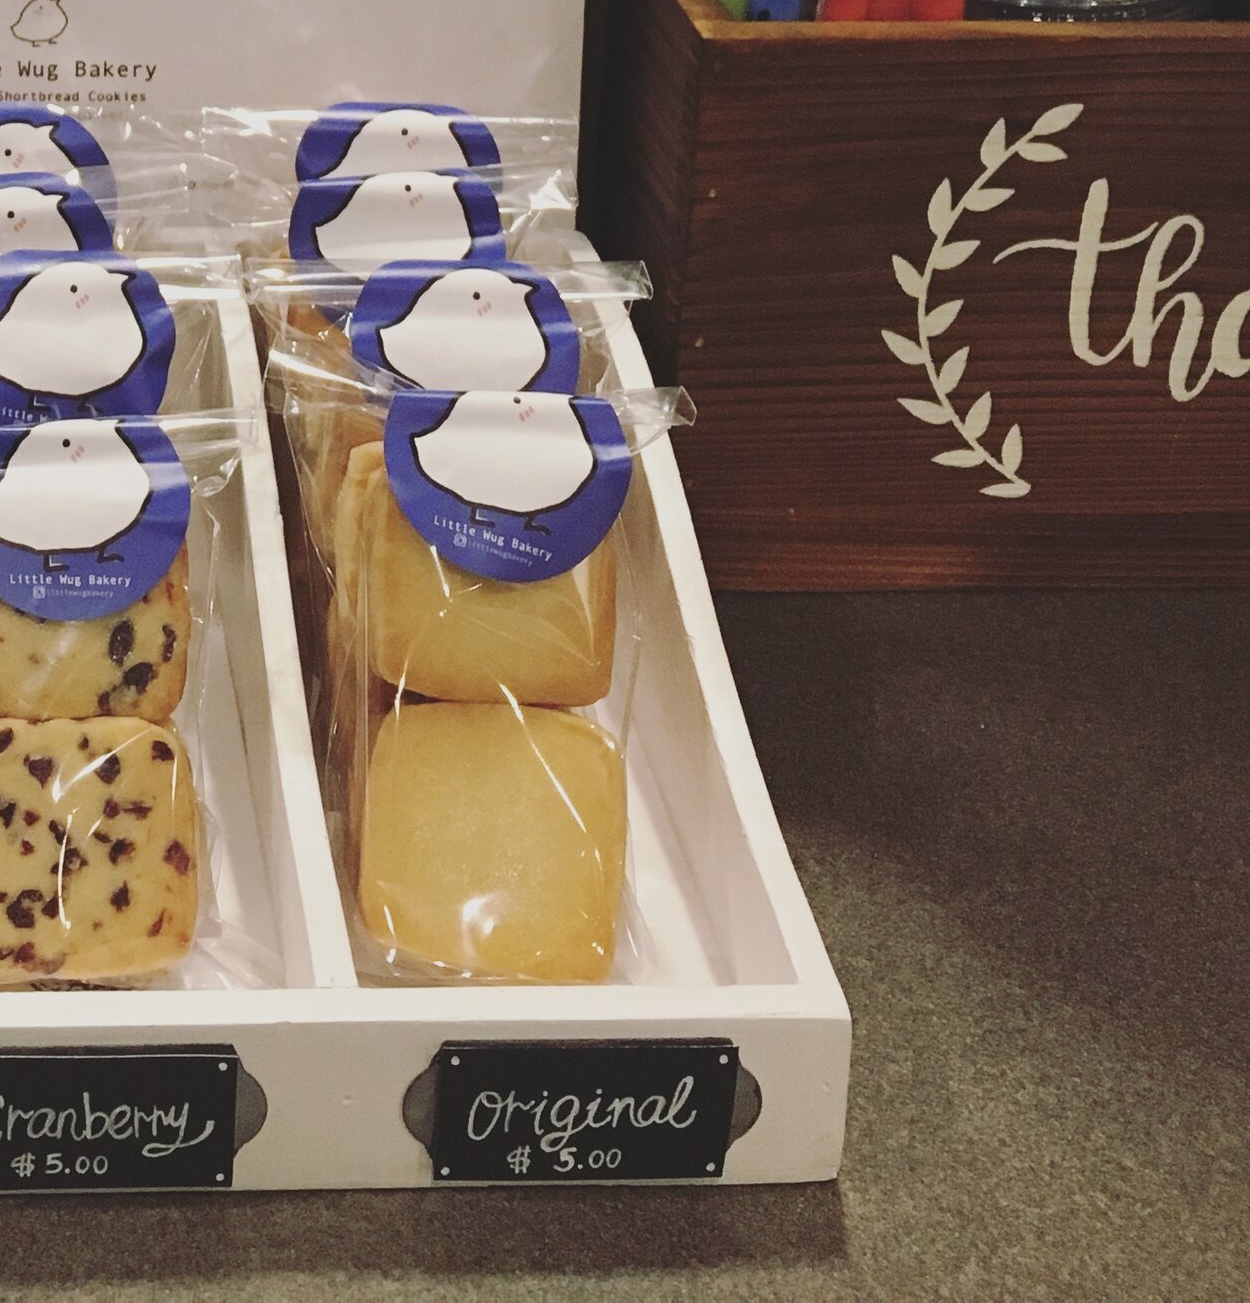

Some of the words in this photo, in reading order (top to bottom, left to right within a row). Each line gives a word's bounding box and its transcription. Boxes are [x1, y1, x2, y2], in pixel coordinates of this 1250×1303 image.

[18, 61, 59, 81] Wug
[74, 61, 157, 82] Bakery
[88, 90, 146, 102] Cookies
[434, 515, 476, 537] Little
[482, 529, 505, 546] Wug
[511, 538, 553, 560] Bakery
[9, 573, 52, 585] Little
[59, 574, 82, 587] Wug
[88, 574, 132, 588] Bakery
[467, 1075, 698, 1152] Original
